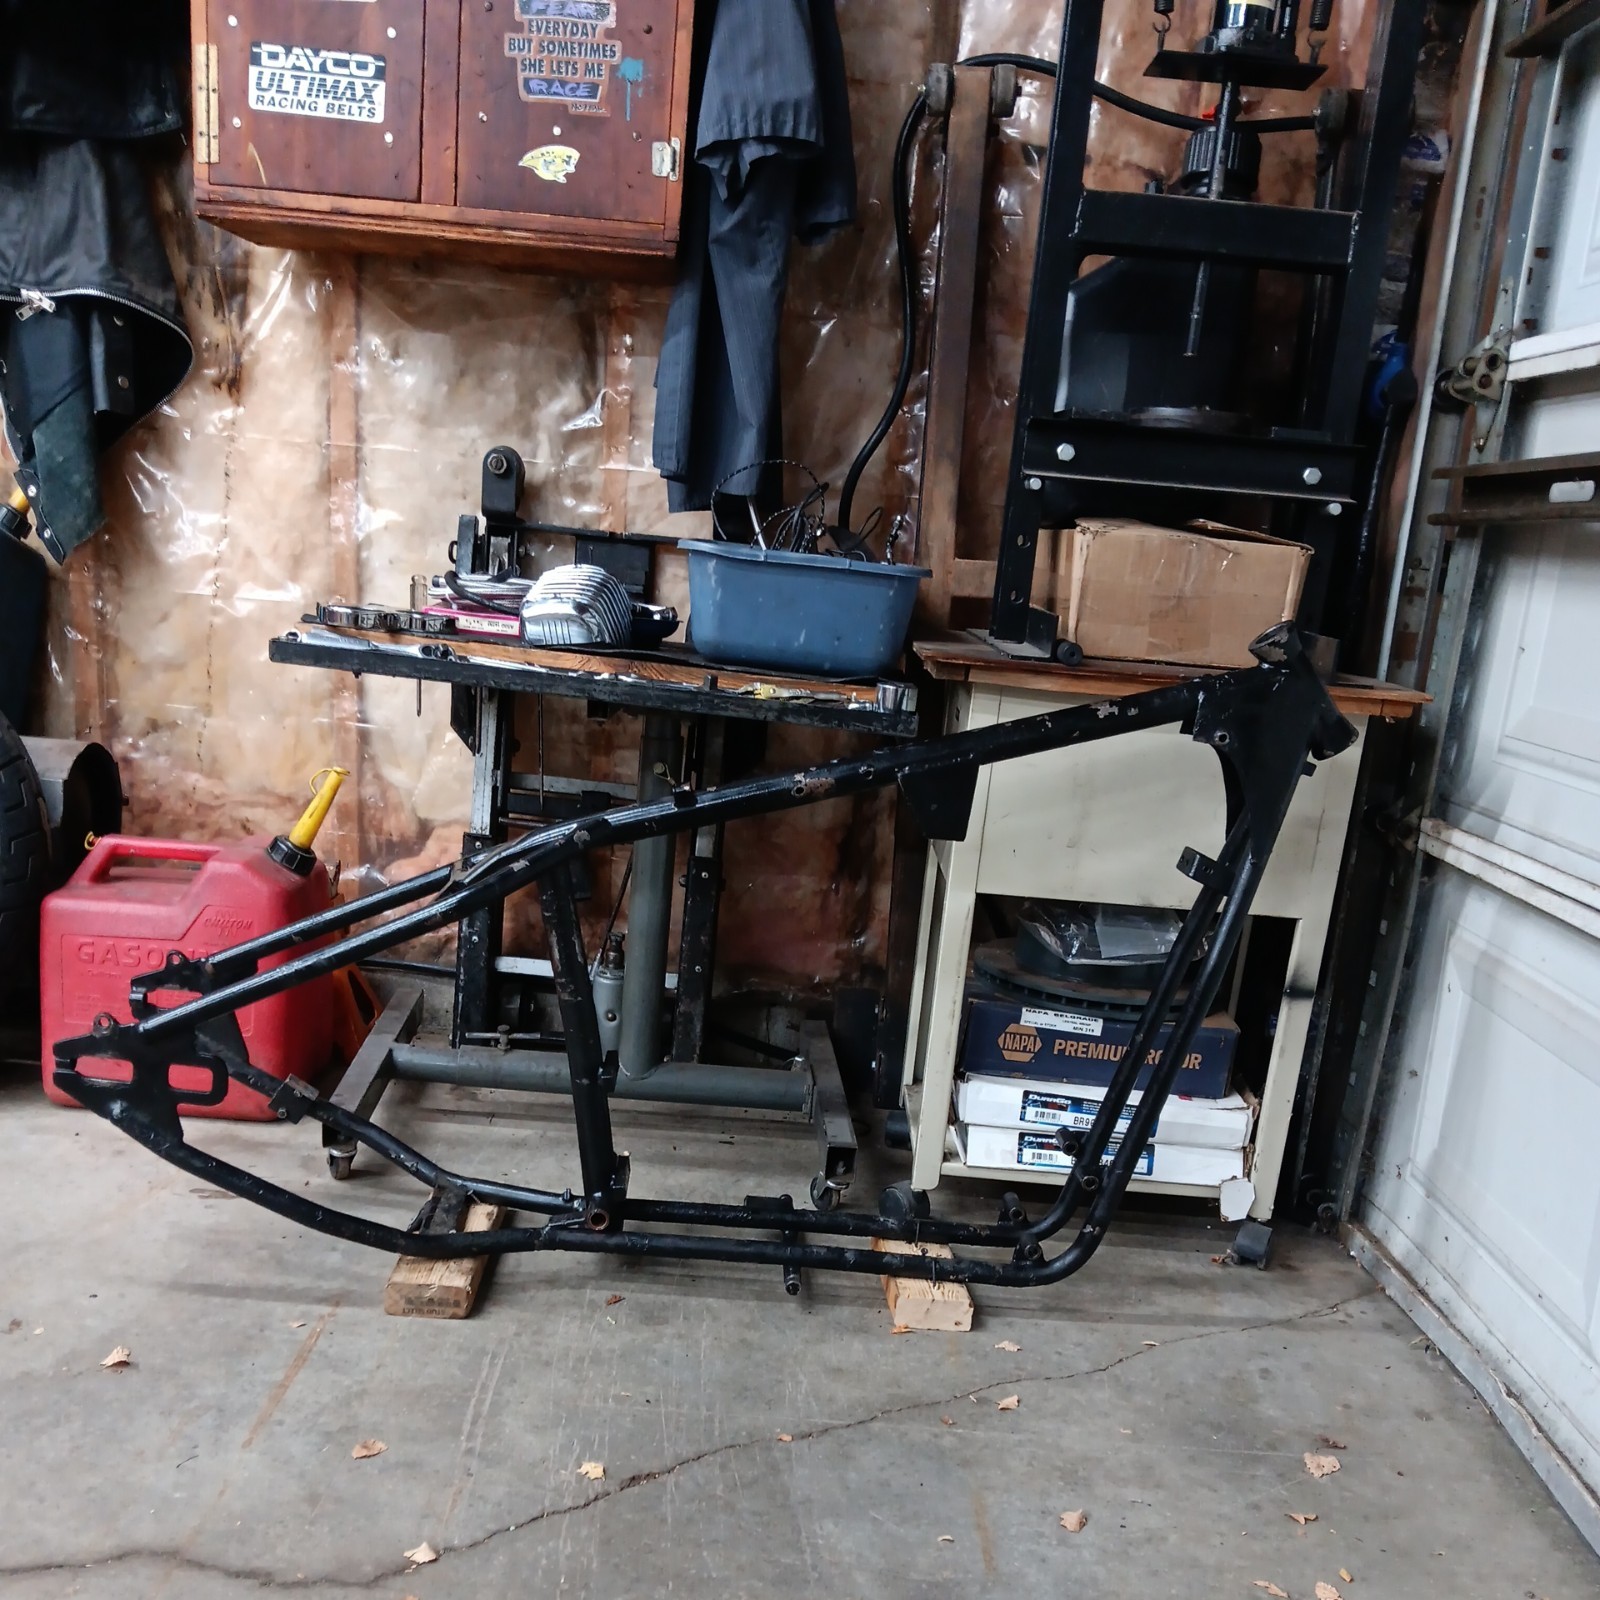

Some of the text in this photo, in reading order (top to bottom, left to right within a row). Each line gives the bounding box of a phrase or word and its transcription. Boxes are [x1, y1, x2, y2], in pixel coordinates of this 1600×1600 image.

[528, 19, 599, 38] EVERYDAY
[508, 38, 617, 59] BUT SOMETIMES
[258, 42, 378, 78] DAYCO
[520, 58, 605, 79] SHE LETS ME
[255, 71, 380, 105] ULTIMAX
[528, 78, 594, 97] RACE
[256, 95, 377, 119] RACING BELTS
[1004, 1033, 1035, 1053] NAPA
[1053, 1039, 1129, 1062] PREMIU
